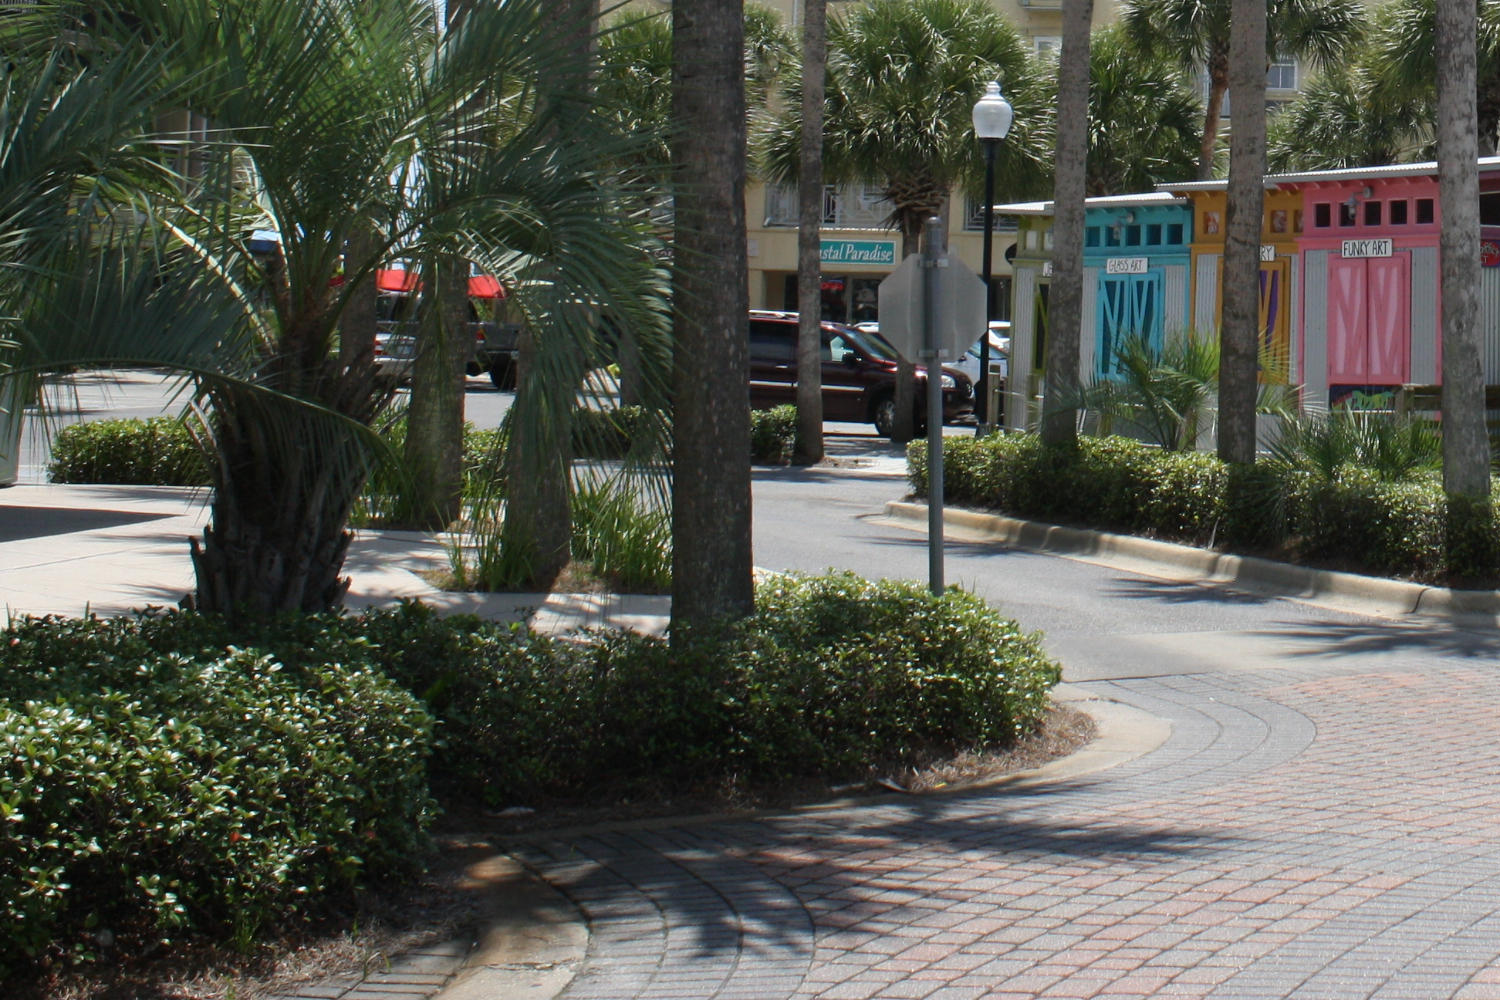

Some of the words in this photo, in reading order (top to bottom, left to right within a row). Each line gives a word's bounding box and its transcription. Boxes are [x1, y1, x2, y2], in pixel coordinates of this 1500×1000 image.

[845, 243, 892, 261] Paradise
[1343, 240, 1370, 257] FUNKY
[1373, 240, 1389, 255] ART
[1109, 259, 1129, 272] GLASS
[1131, 259, 1142, 271] ART
